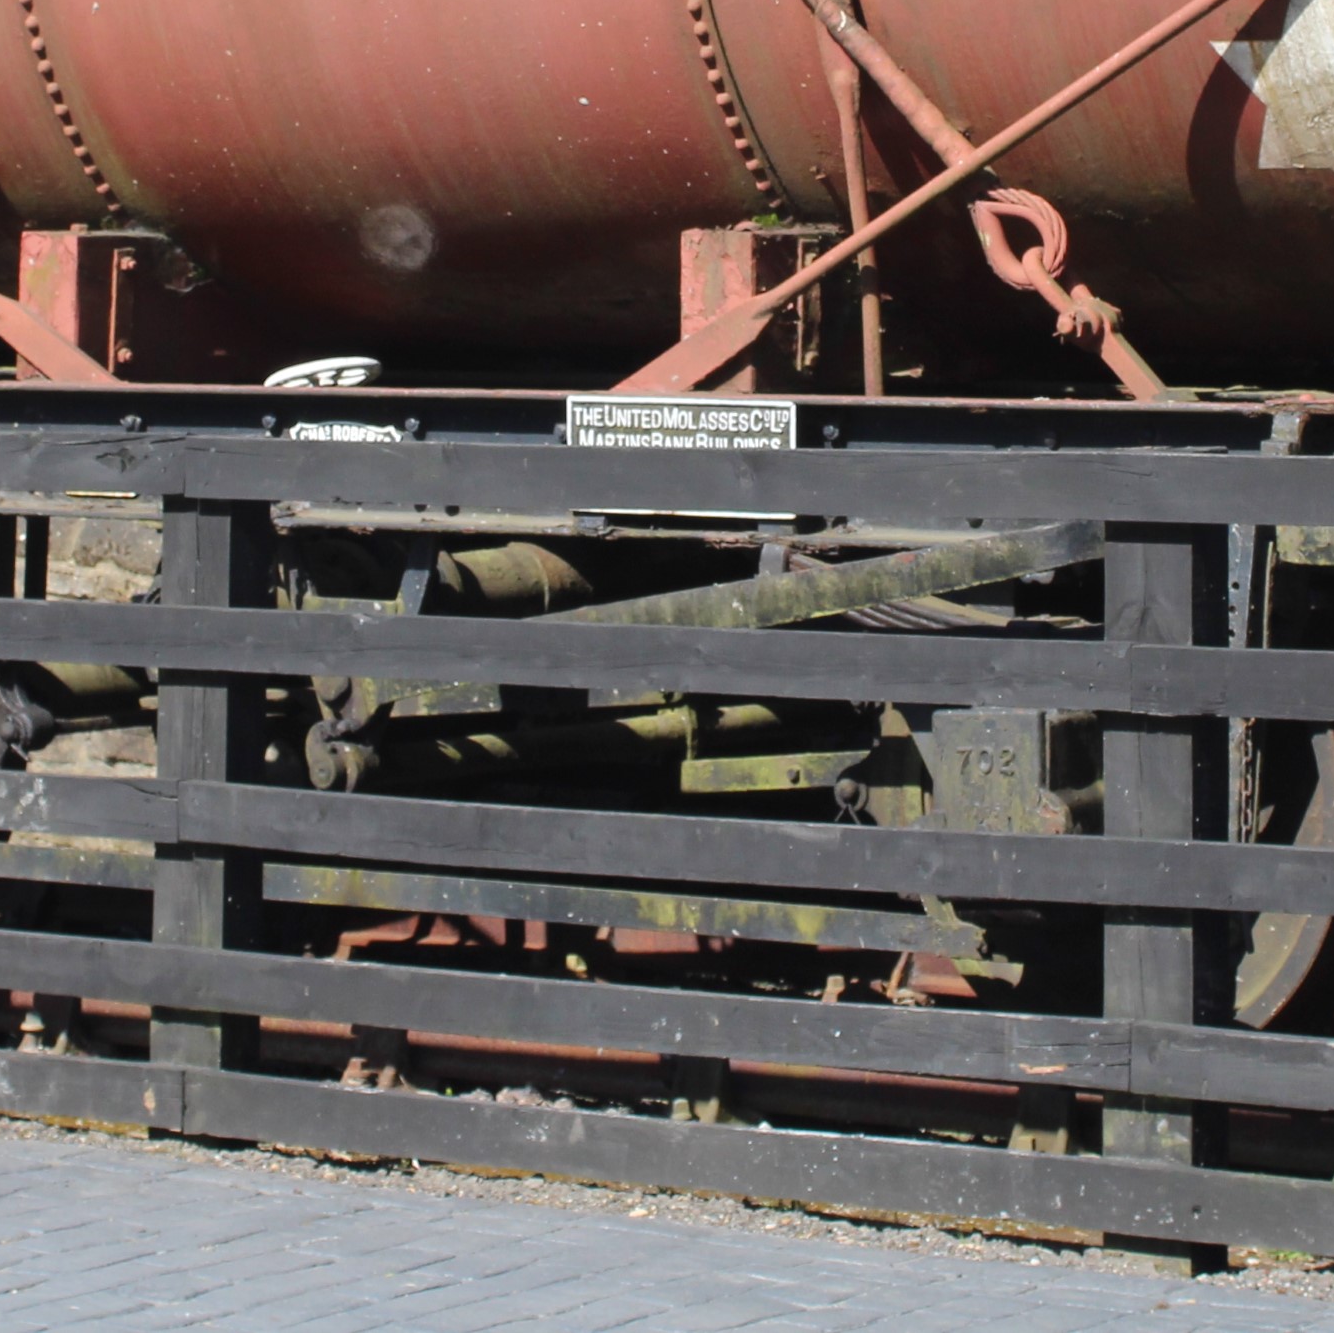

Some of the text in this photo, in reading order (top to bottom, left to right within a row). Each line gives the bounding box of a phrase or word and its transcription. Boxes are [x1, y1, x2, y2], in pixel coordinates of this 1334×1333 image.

[574, 406, 604, 427] THE
[604, 405, 662, 428] UNITED
[663, 406, 749, 432] MOLASSES
[955, 745, 1016, 777] 702
